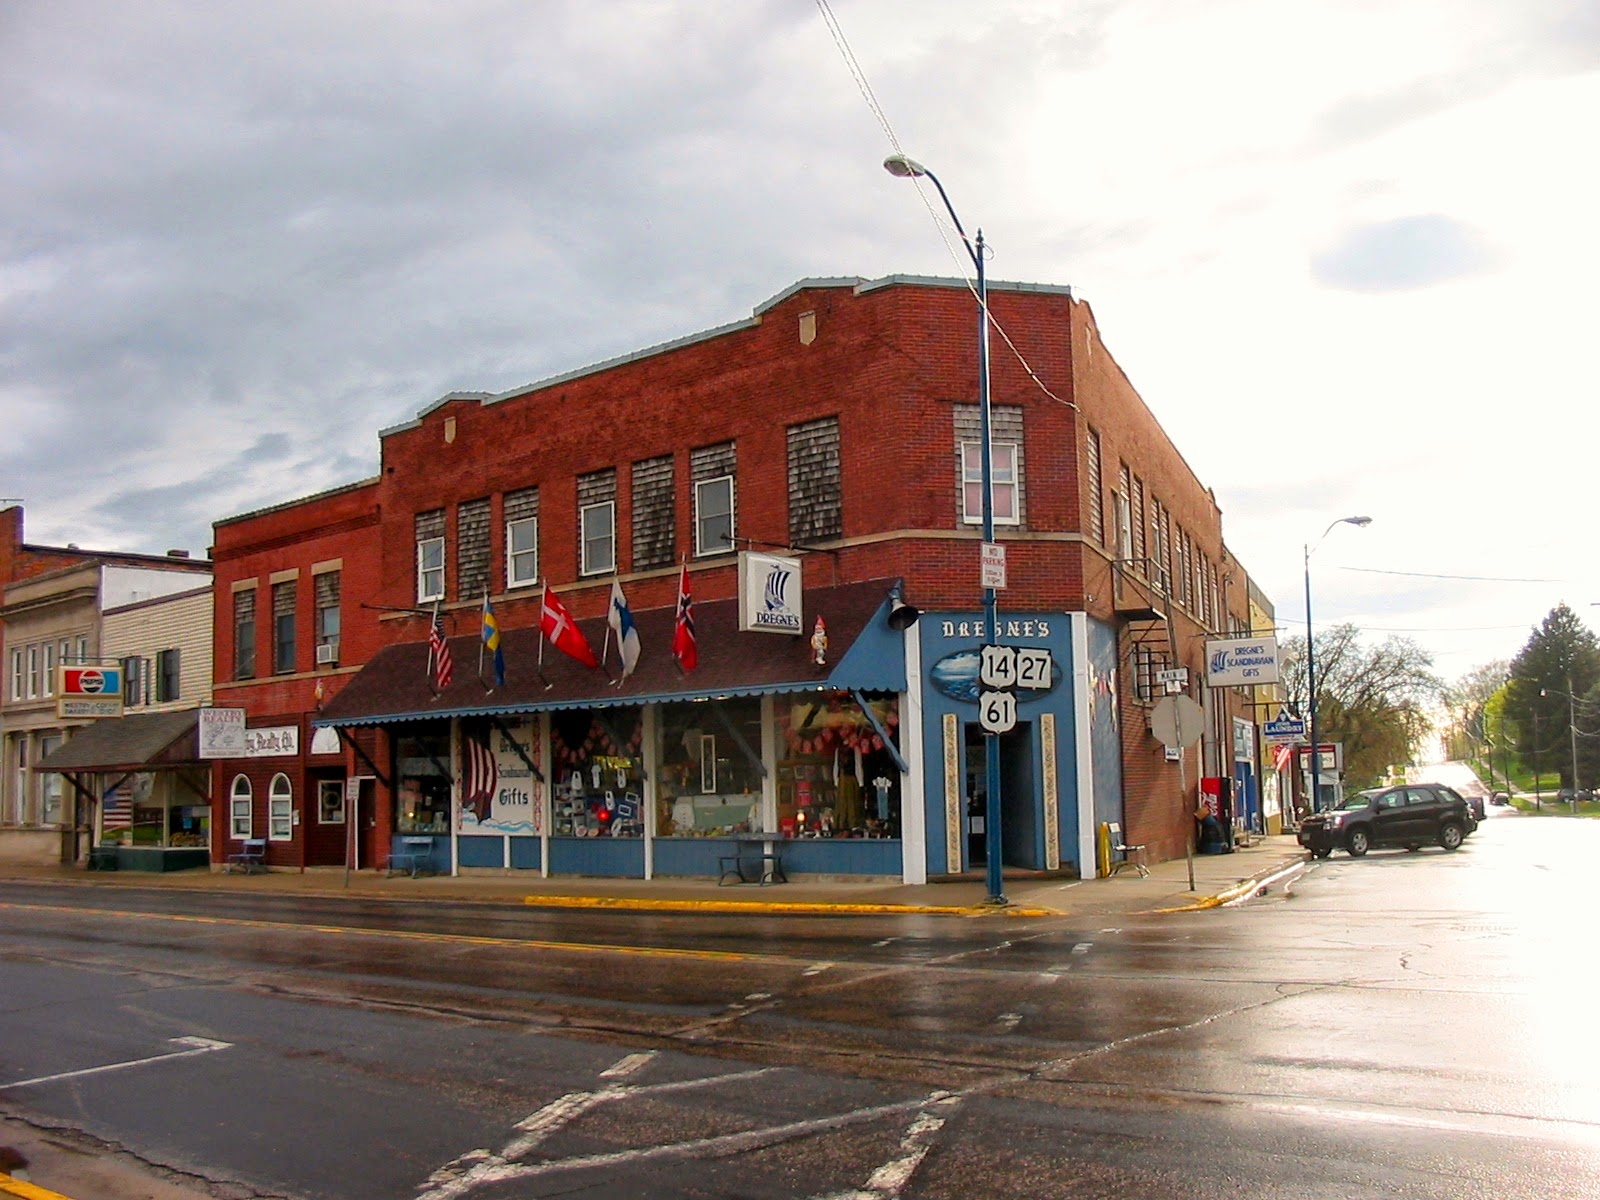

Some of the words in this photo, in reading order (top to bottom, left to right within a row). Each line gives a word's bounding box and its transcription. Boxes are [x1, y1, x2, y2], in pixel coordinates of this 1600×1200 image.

[989, 547, 998, 557] NO
[982, 556, 1004, 567] PARKING
[756, 612, 800, 627] DREGNE'S
[988, 655, 1009, 678] 14
[1226, 657, 1275, 667] SCANDINAVIAN
[1021, 656, 1048, 680] 27
[1242, 668, 1260, 677] GIFTS
[987, 700, 1009, 724] 61
[203, 715, 241, 723] REALTY
[1265, 723, 1303, 733] LAUNDRY
[499, 787, 529, 805] Gifts
